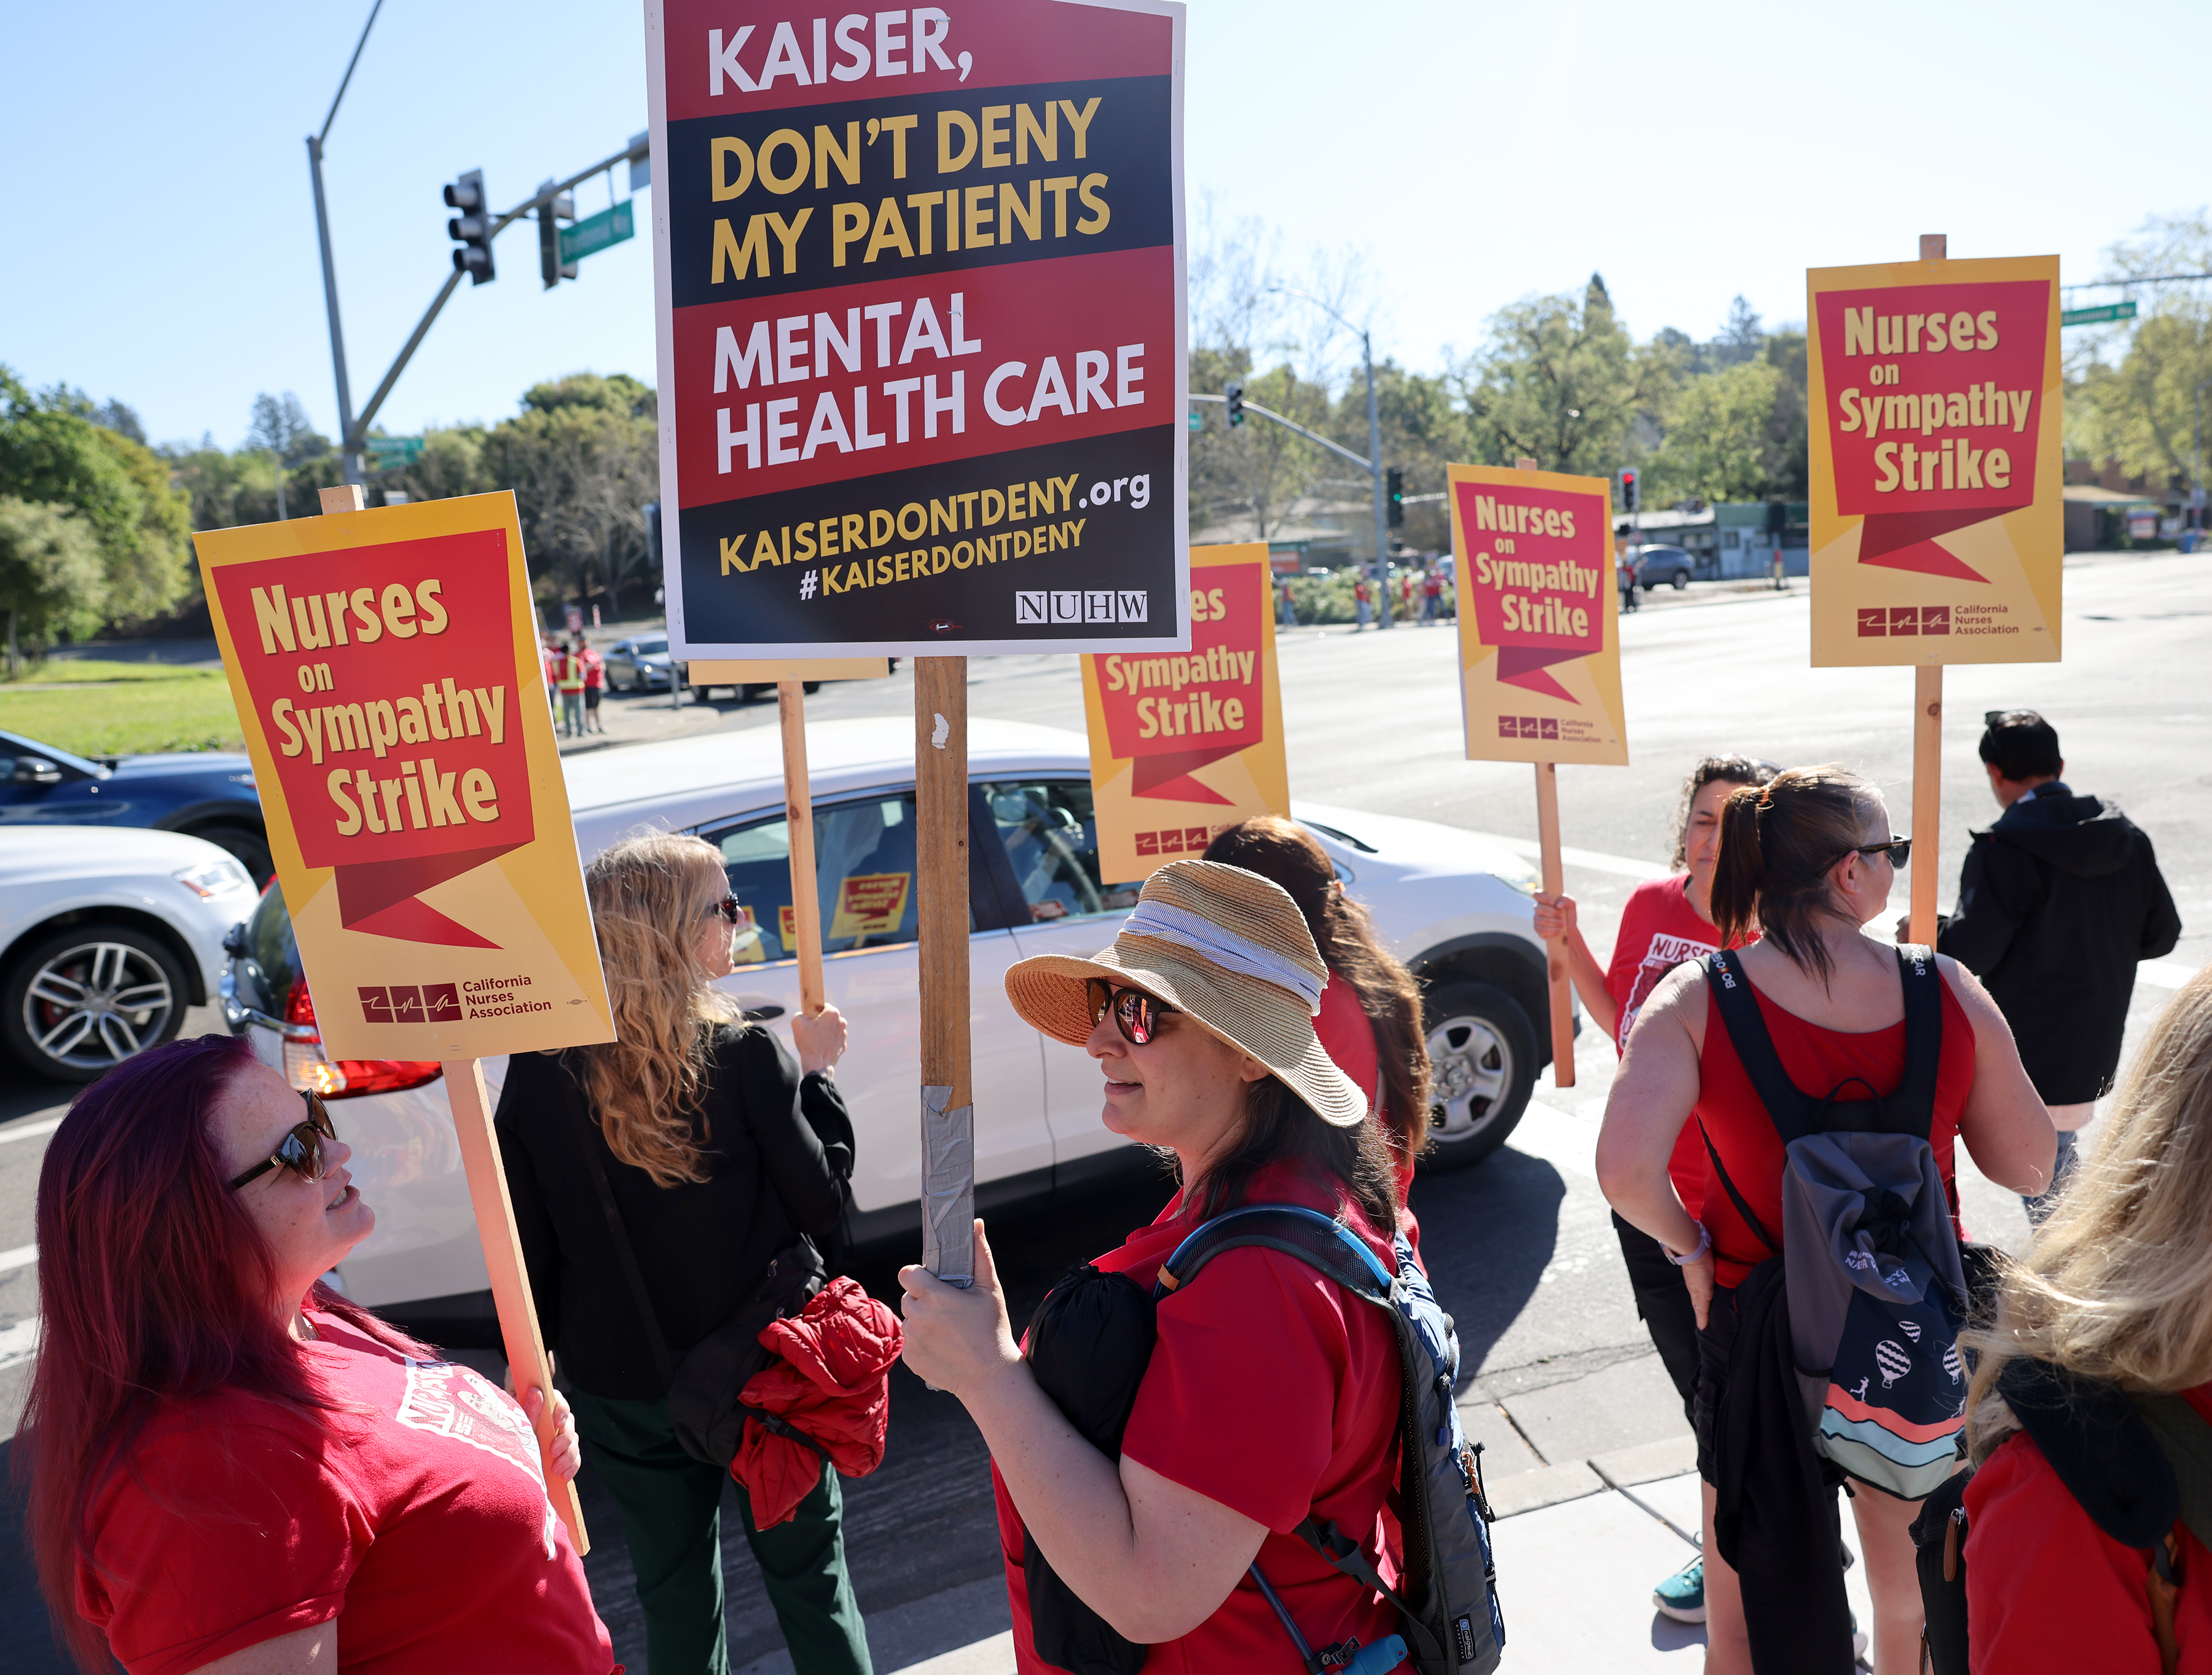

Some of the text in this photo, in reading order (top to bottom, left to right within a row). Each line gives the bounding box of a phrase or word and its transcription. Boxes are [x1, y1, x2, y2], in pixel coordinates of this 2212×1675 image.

[708, 7, 973, 96] KAISER,
[711, 97, 1102, 202] DON'T DENY
[711, 207, 814, 284] MY
[833, 173, 1110, 267] PATIENTS
[713, 292, 982, 394] MENTAL
[1845, 306, 1999, 356] Nurses
[1870, 364, 1899, 386] on
[716, 343, 1145, 474] HEALTH CARE
[1840, 382, 2033, 439] Sympathy
[1875, 438, 2011, 493] Strike
[720, 473, 1150, 576] KAISERDONTDENY.org
[1475, 495, 1577, 539] Nurses
[799, 518, 1086, 601] #KAISERDONTDENY
[1495, 538, 1516, 554] on
[1476, 552, 1599, 599] Sympathy
[250, 579, 450, 656] Nurses
[1018, 594, 1148, 621] NUHW
[1502, 594, 1590, 638] Strike
[1955, 604, 2008, 614] California
[1955, 616, 1992, 624] Nurses
[1955, 625, 2019, 635] Association
[297, 662, 335, 693] on
[1105, 645, 1255, 696] Sympathy
[272, 677, 506, 765] Sympathy
[1137, 691, 1244, 739] Strike
[327, 758, 501, 836] Strike
[1652, 937, 1712, 961] NURSE
[462, 974, 532, 992] California
[465, 990, 514, 1006] Nurses
[469, 1000, 552, 1019] Association
[1463, 1630, 1472, 1657] nalgene
